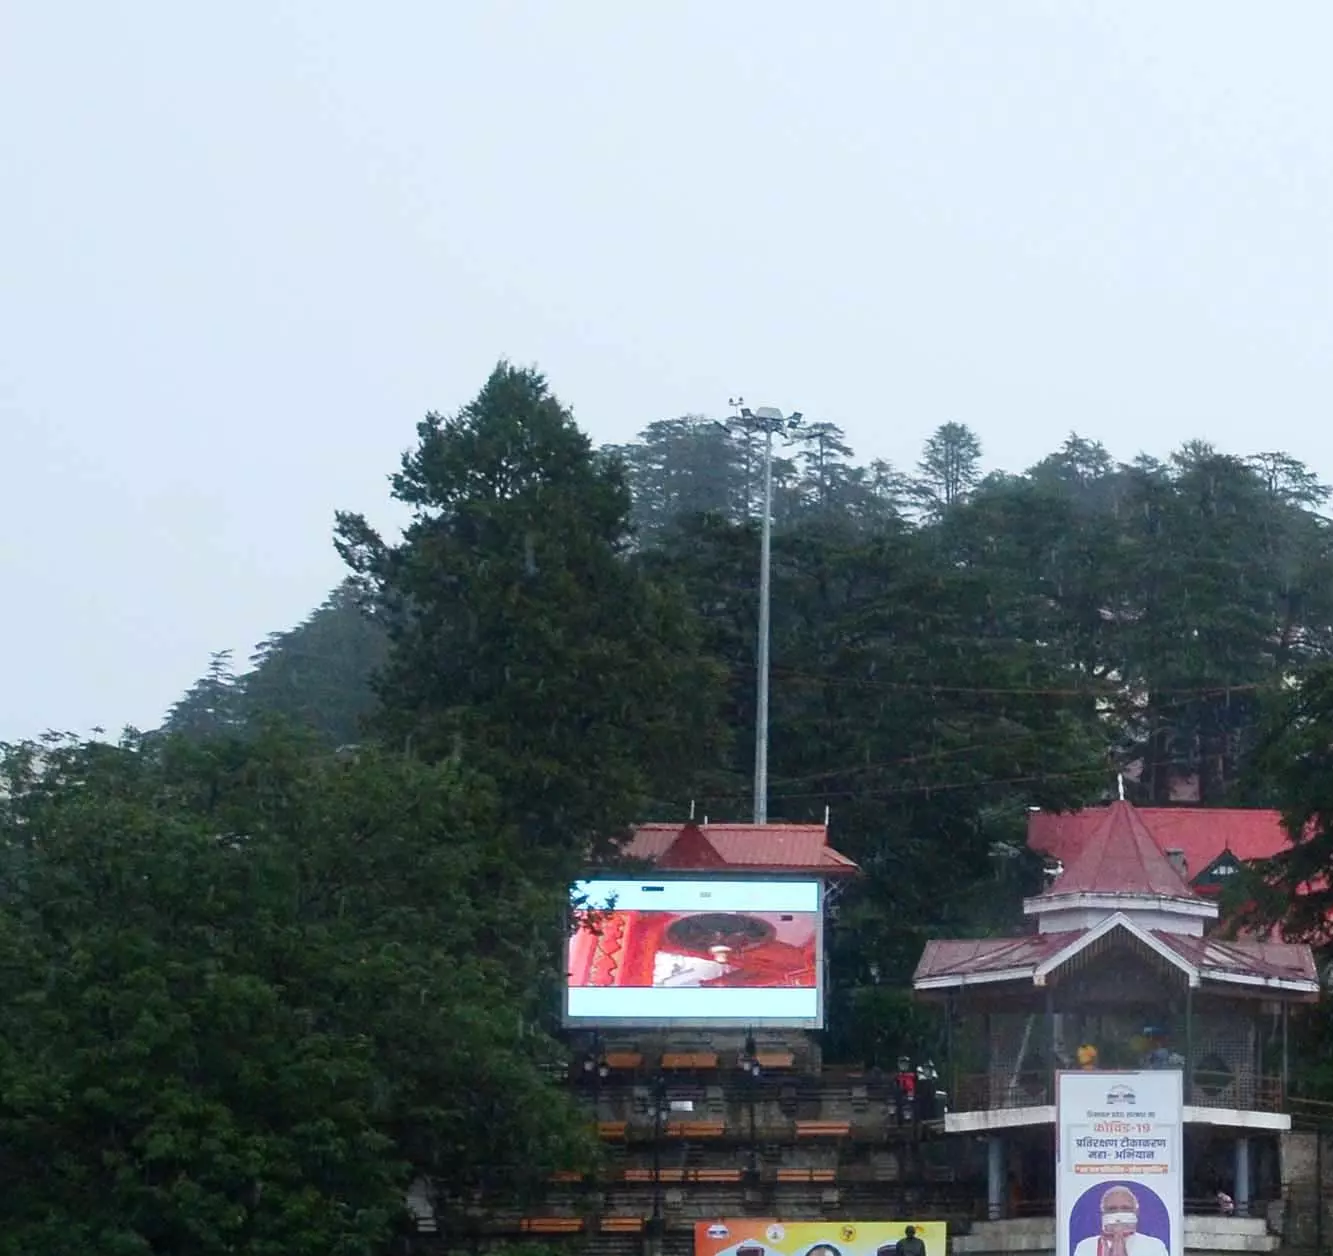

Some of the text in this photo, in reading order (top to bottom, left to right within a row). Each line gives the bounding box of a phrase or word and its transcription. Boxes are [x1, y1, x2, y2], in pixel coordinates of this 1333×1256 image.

[1076, 1136, 1167, 1148] प्रतिरक्षण टीकाकरण
[1114, 1149, 1155, 1160] अभियान
